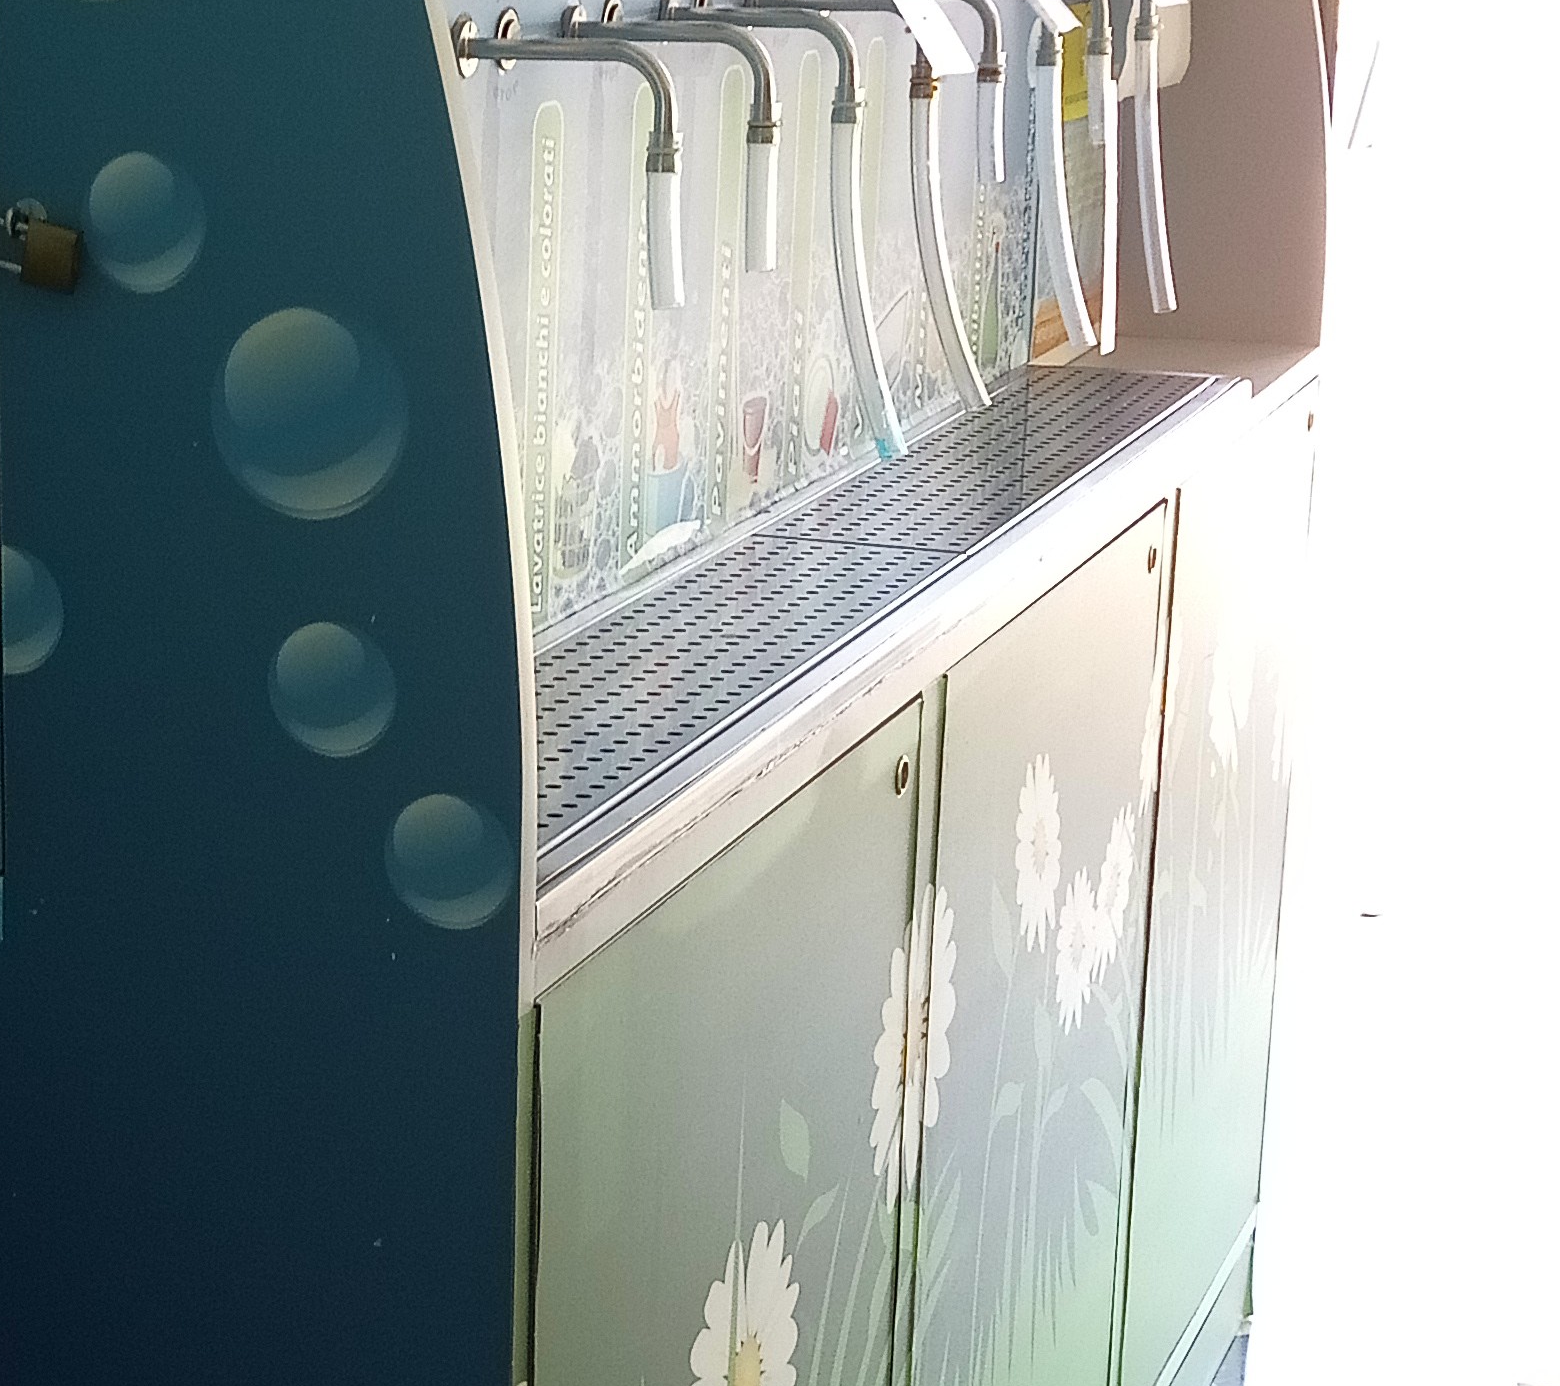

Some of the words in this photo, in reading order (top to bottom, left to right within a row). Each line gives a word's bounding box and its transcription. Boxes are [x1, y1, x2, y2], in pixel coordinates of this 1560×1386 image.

[540, 138, 555, 278] colorati
[540, 287, 551, 306] e
[533, 316, 549, 446] bianchi
[711, 244, 732, 516] Pavimenti
[787, 309, 804, 476] Piatti
[530, 451, 547, 613] Lavatrice
